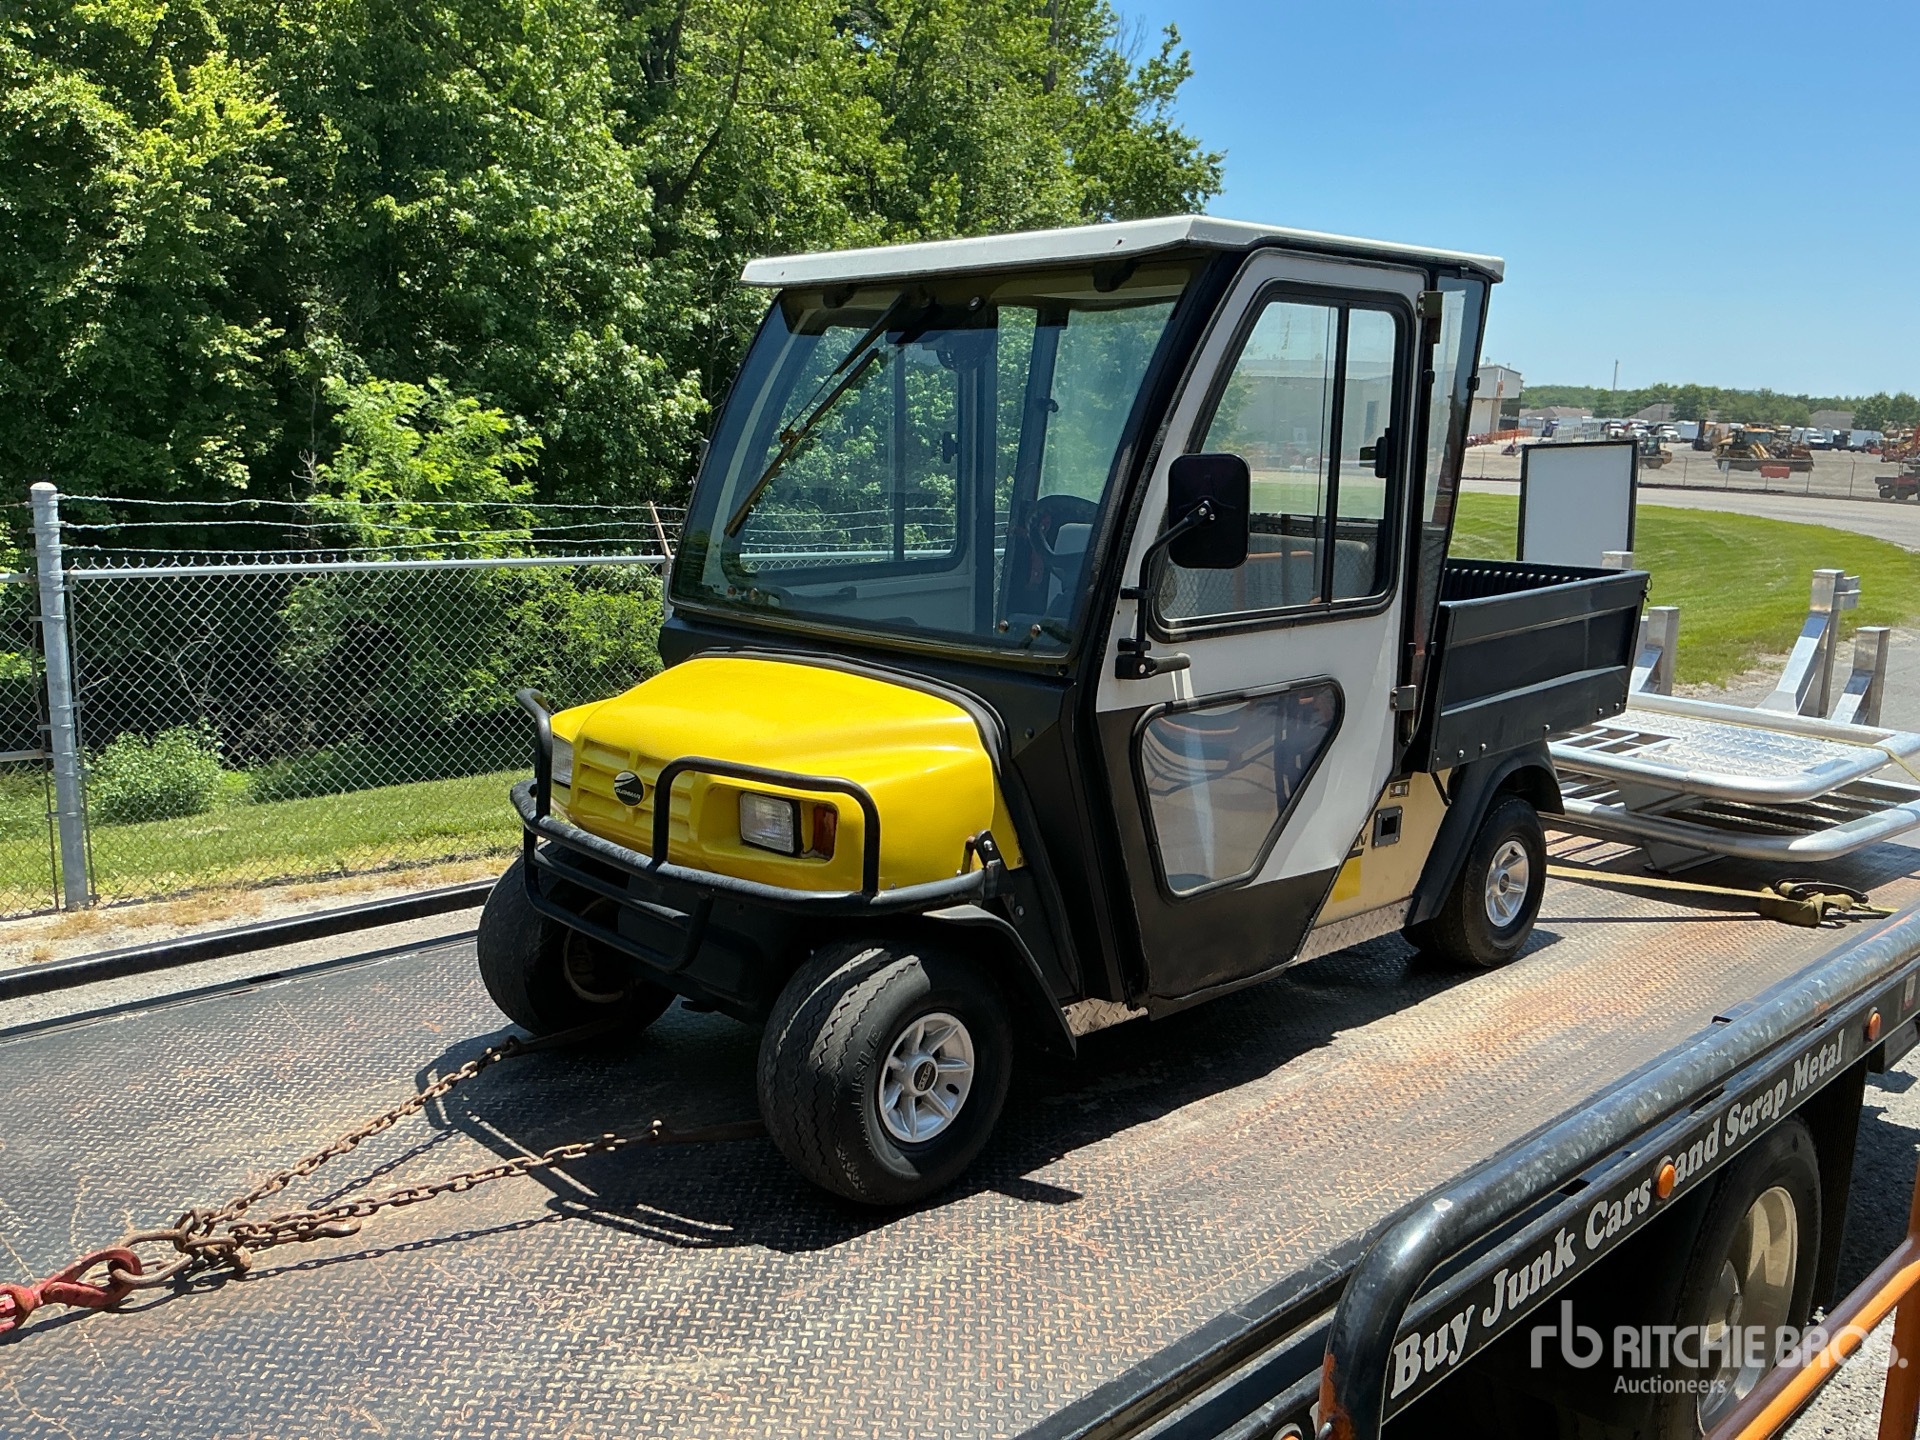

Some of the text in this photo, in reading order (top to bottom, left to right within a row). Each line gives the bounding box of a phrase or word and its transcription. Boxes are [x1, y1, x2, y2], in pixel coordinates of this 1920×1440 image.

[1390, 1028, 1844, 1400] Buy Junk Cars and Scrap Metal
